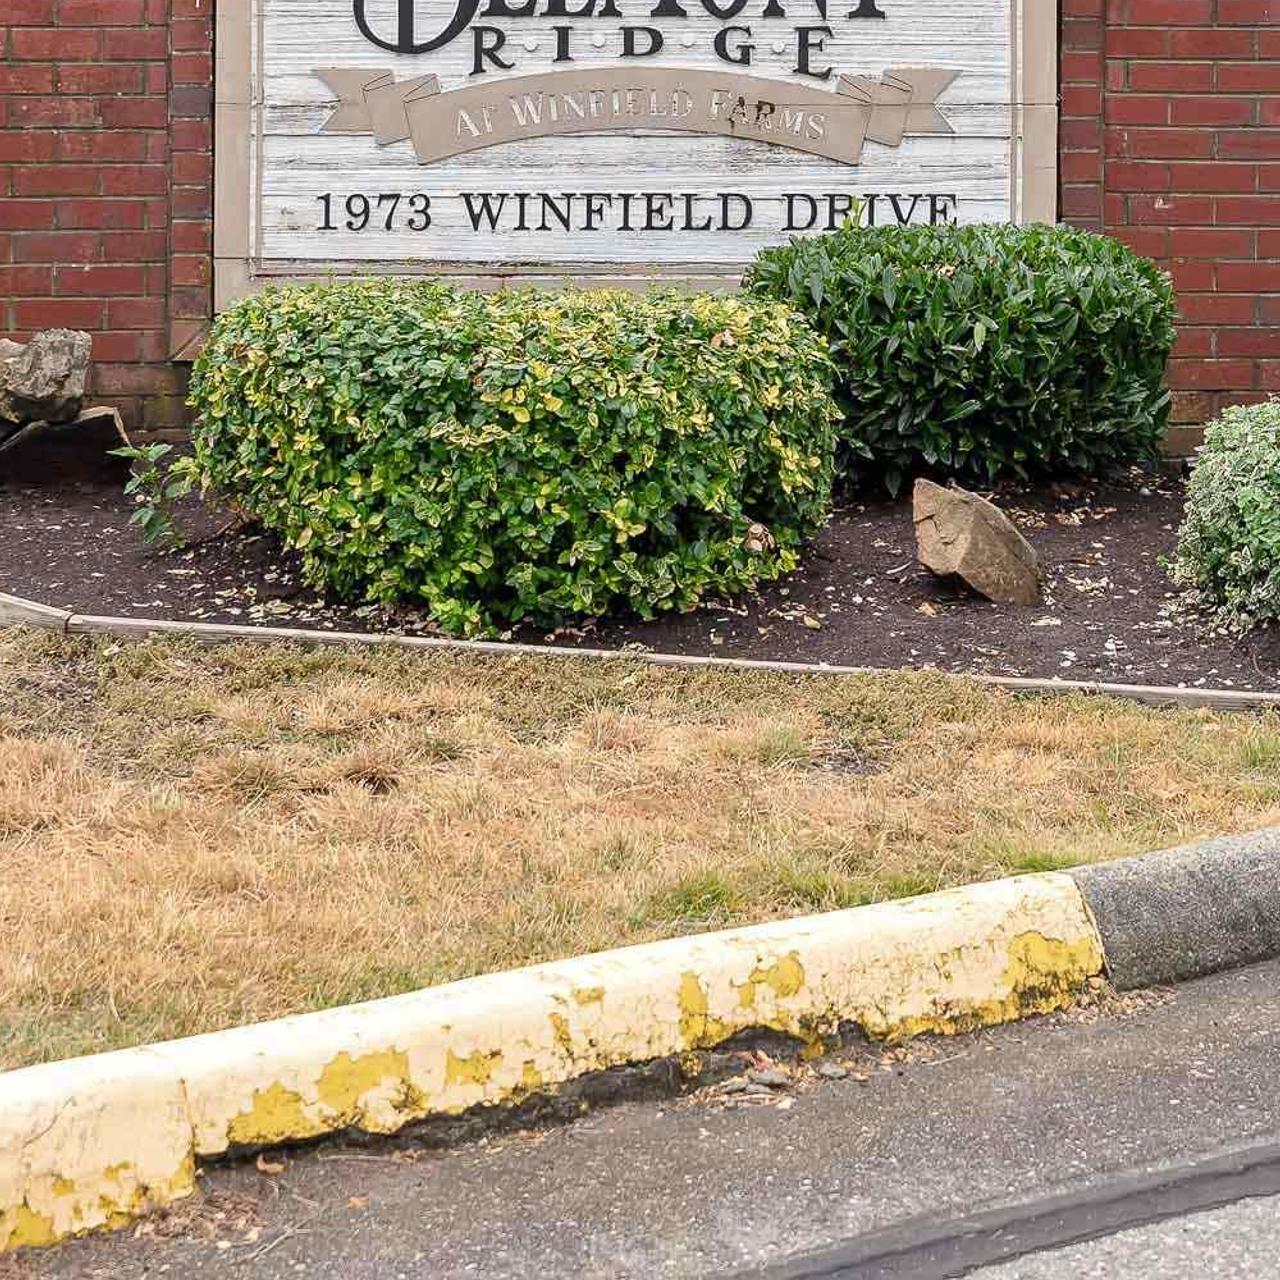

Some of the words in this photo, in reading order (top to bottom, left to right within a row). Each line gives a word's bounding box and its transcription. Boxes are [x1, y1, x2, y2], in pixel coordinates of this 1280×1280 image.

[468, 24, 835, 79] RIDGE
[508, 86, 694, 127] WINFIELD
[708, 88, 827, 141] FARMS
[315, 192, 432, 231] 1973
[458, 192, 754, 232] WINFIELD
[780, 192, 959, 232] DRIVE
